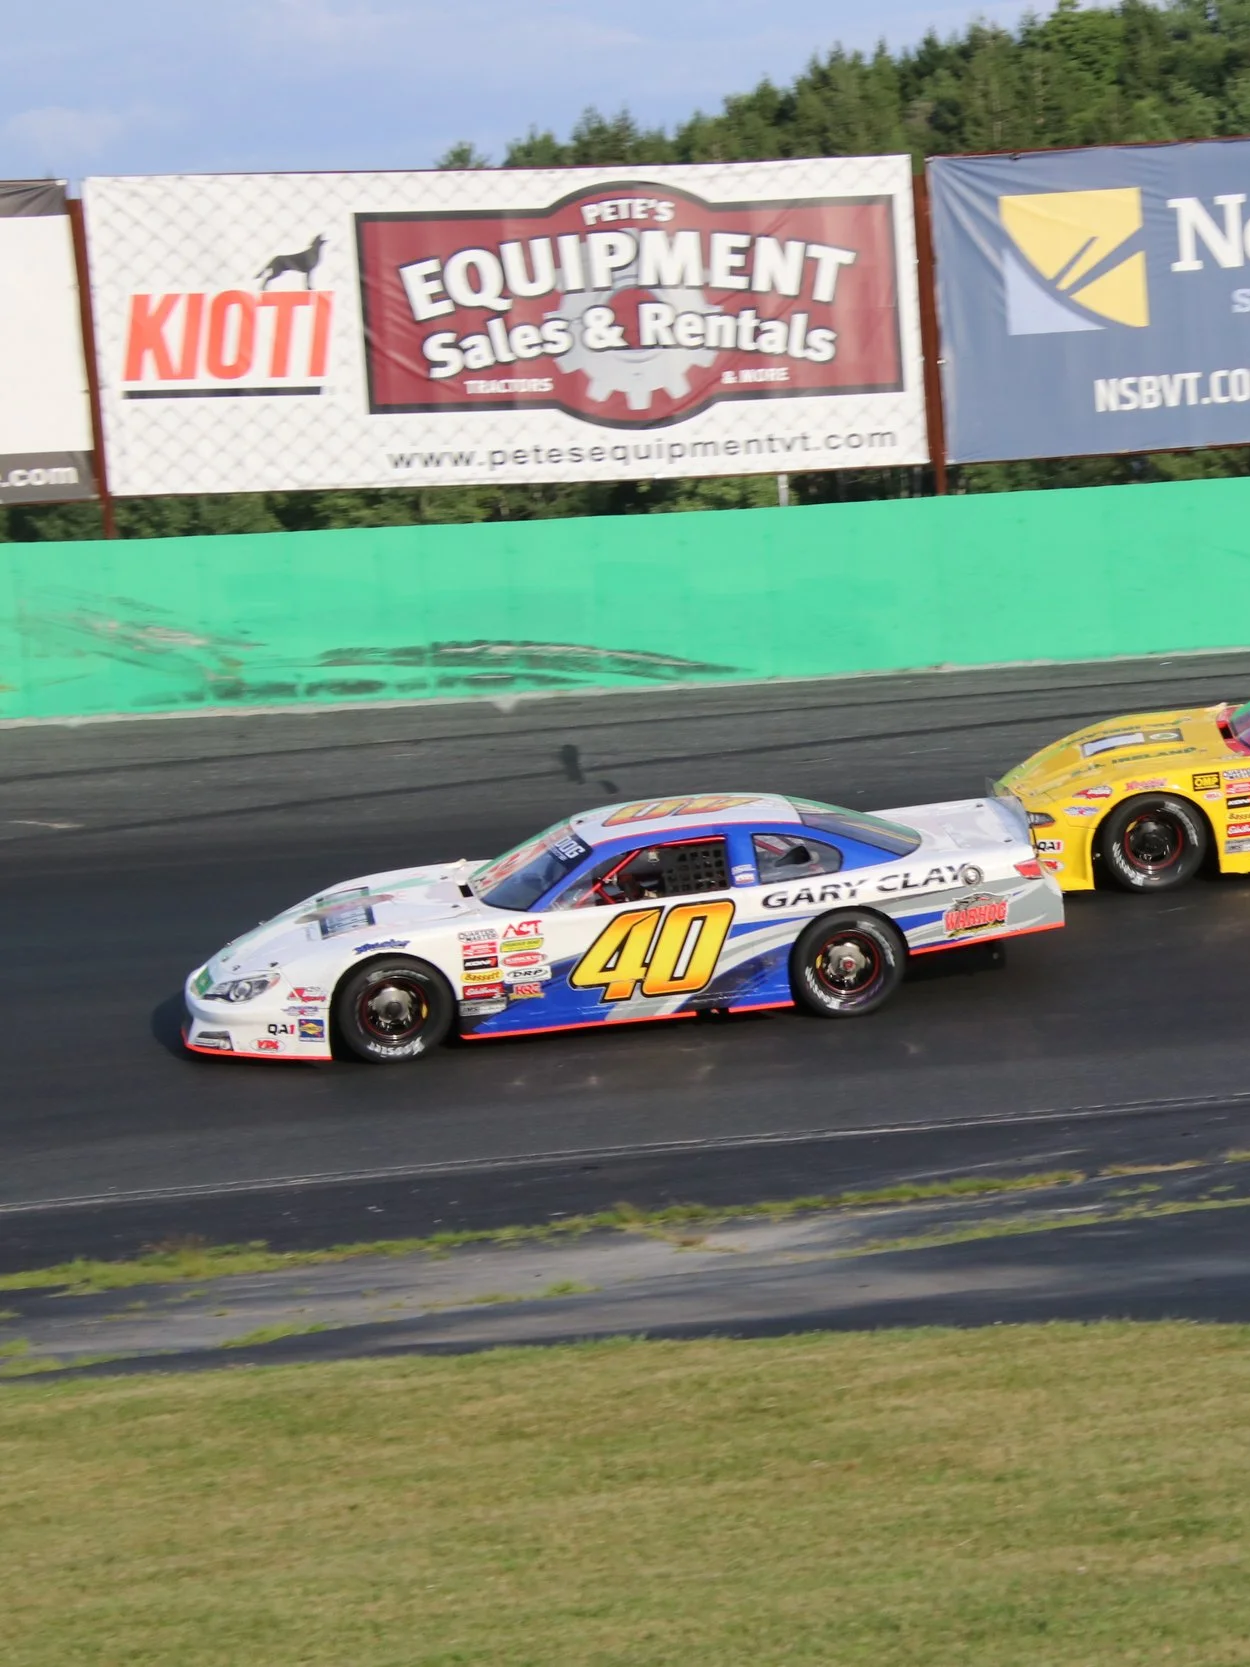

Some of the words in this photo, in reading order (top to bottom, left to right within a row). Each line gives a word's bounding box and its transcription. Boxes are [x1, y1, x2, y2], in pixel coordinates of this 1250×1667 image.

[581, 197, 675, 226] PETE'S
[399, 228, 857, 322] EQUIPMENT
[122, 288, 335, 382] KIOTI
[422, 312, 573, 380] Sales
[581, 305, 625, 352] &
[639, 302, 838, 363] Rentals
[465, 377, 553, 395] TRACTORS
[739, 366, 790, 383] MORE
[387, 427, 898, 470] www.petesequipmentvt.com
[1194, 775, 1219, 788] OMP
[761, 879, 867, 909] GARY
[876, 862, 970, 893] CLAY
[502, 919, 543, 939] ACT
[945, 900, 1008, 931] WARHOG
[568, 898, 736, 1004] 40
[513, 969, 542, 979] DRP
[267, 1023, 296, 1036] QA1
